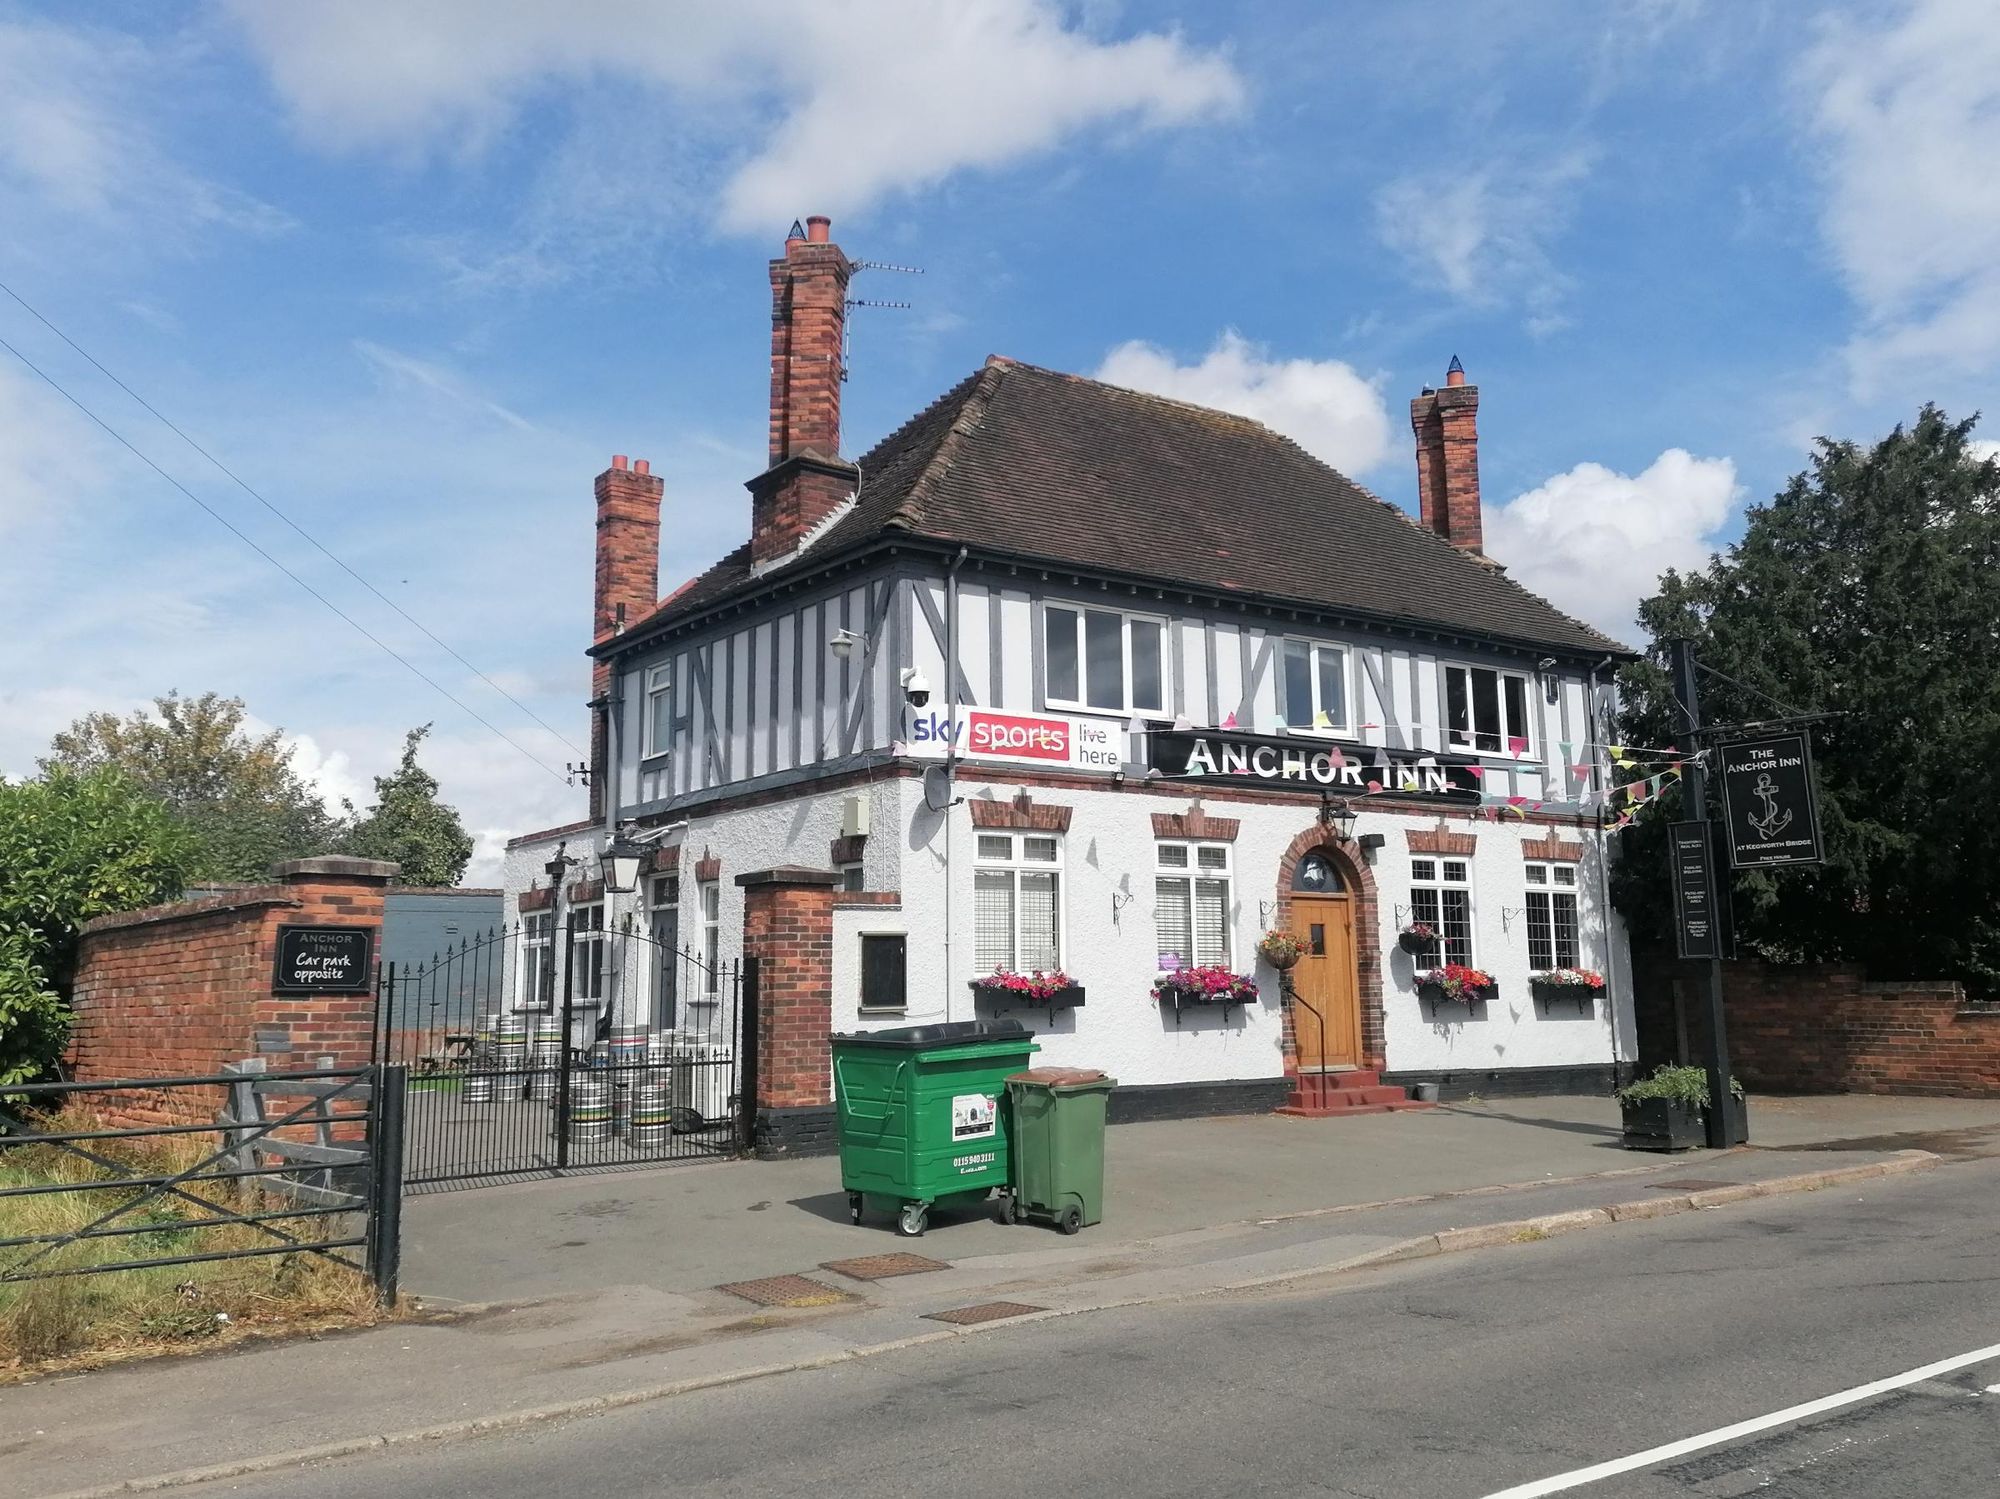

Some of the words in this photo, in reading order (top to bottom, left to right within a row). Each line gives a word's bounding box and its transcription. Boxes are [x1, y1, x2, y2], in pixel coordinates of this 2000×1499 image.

[974, 722, 1064, 751] sports
[1079, 724, 1107, 743] live
[1079, 745, 1118, 765] here
[1749, 749, 1775, 760] THE
[1184, 739, 1365, 786] ANCHOR
[1376, 757, 1448, 793] INN
[1727, 760, 1777, 773] ANCHOR
[1779, 757, 1801, 767] INN
[1746, 842, 1785, 850] KEGWORTH
[1785, 839, 1812, 847] BRIDGE
[300, 933, 353, 943] ANCHOR
[314, 944, 338, 953] INN
[296, 952, 320, 966] Car
[322, 954, 352, 970] park
[294, 967, 344, 983] opposite
